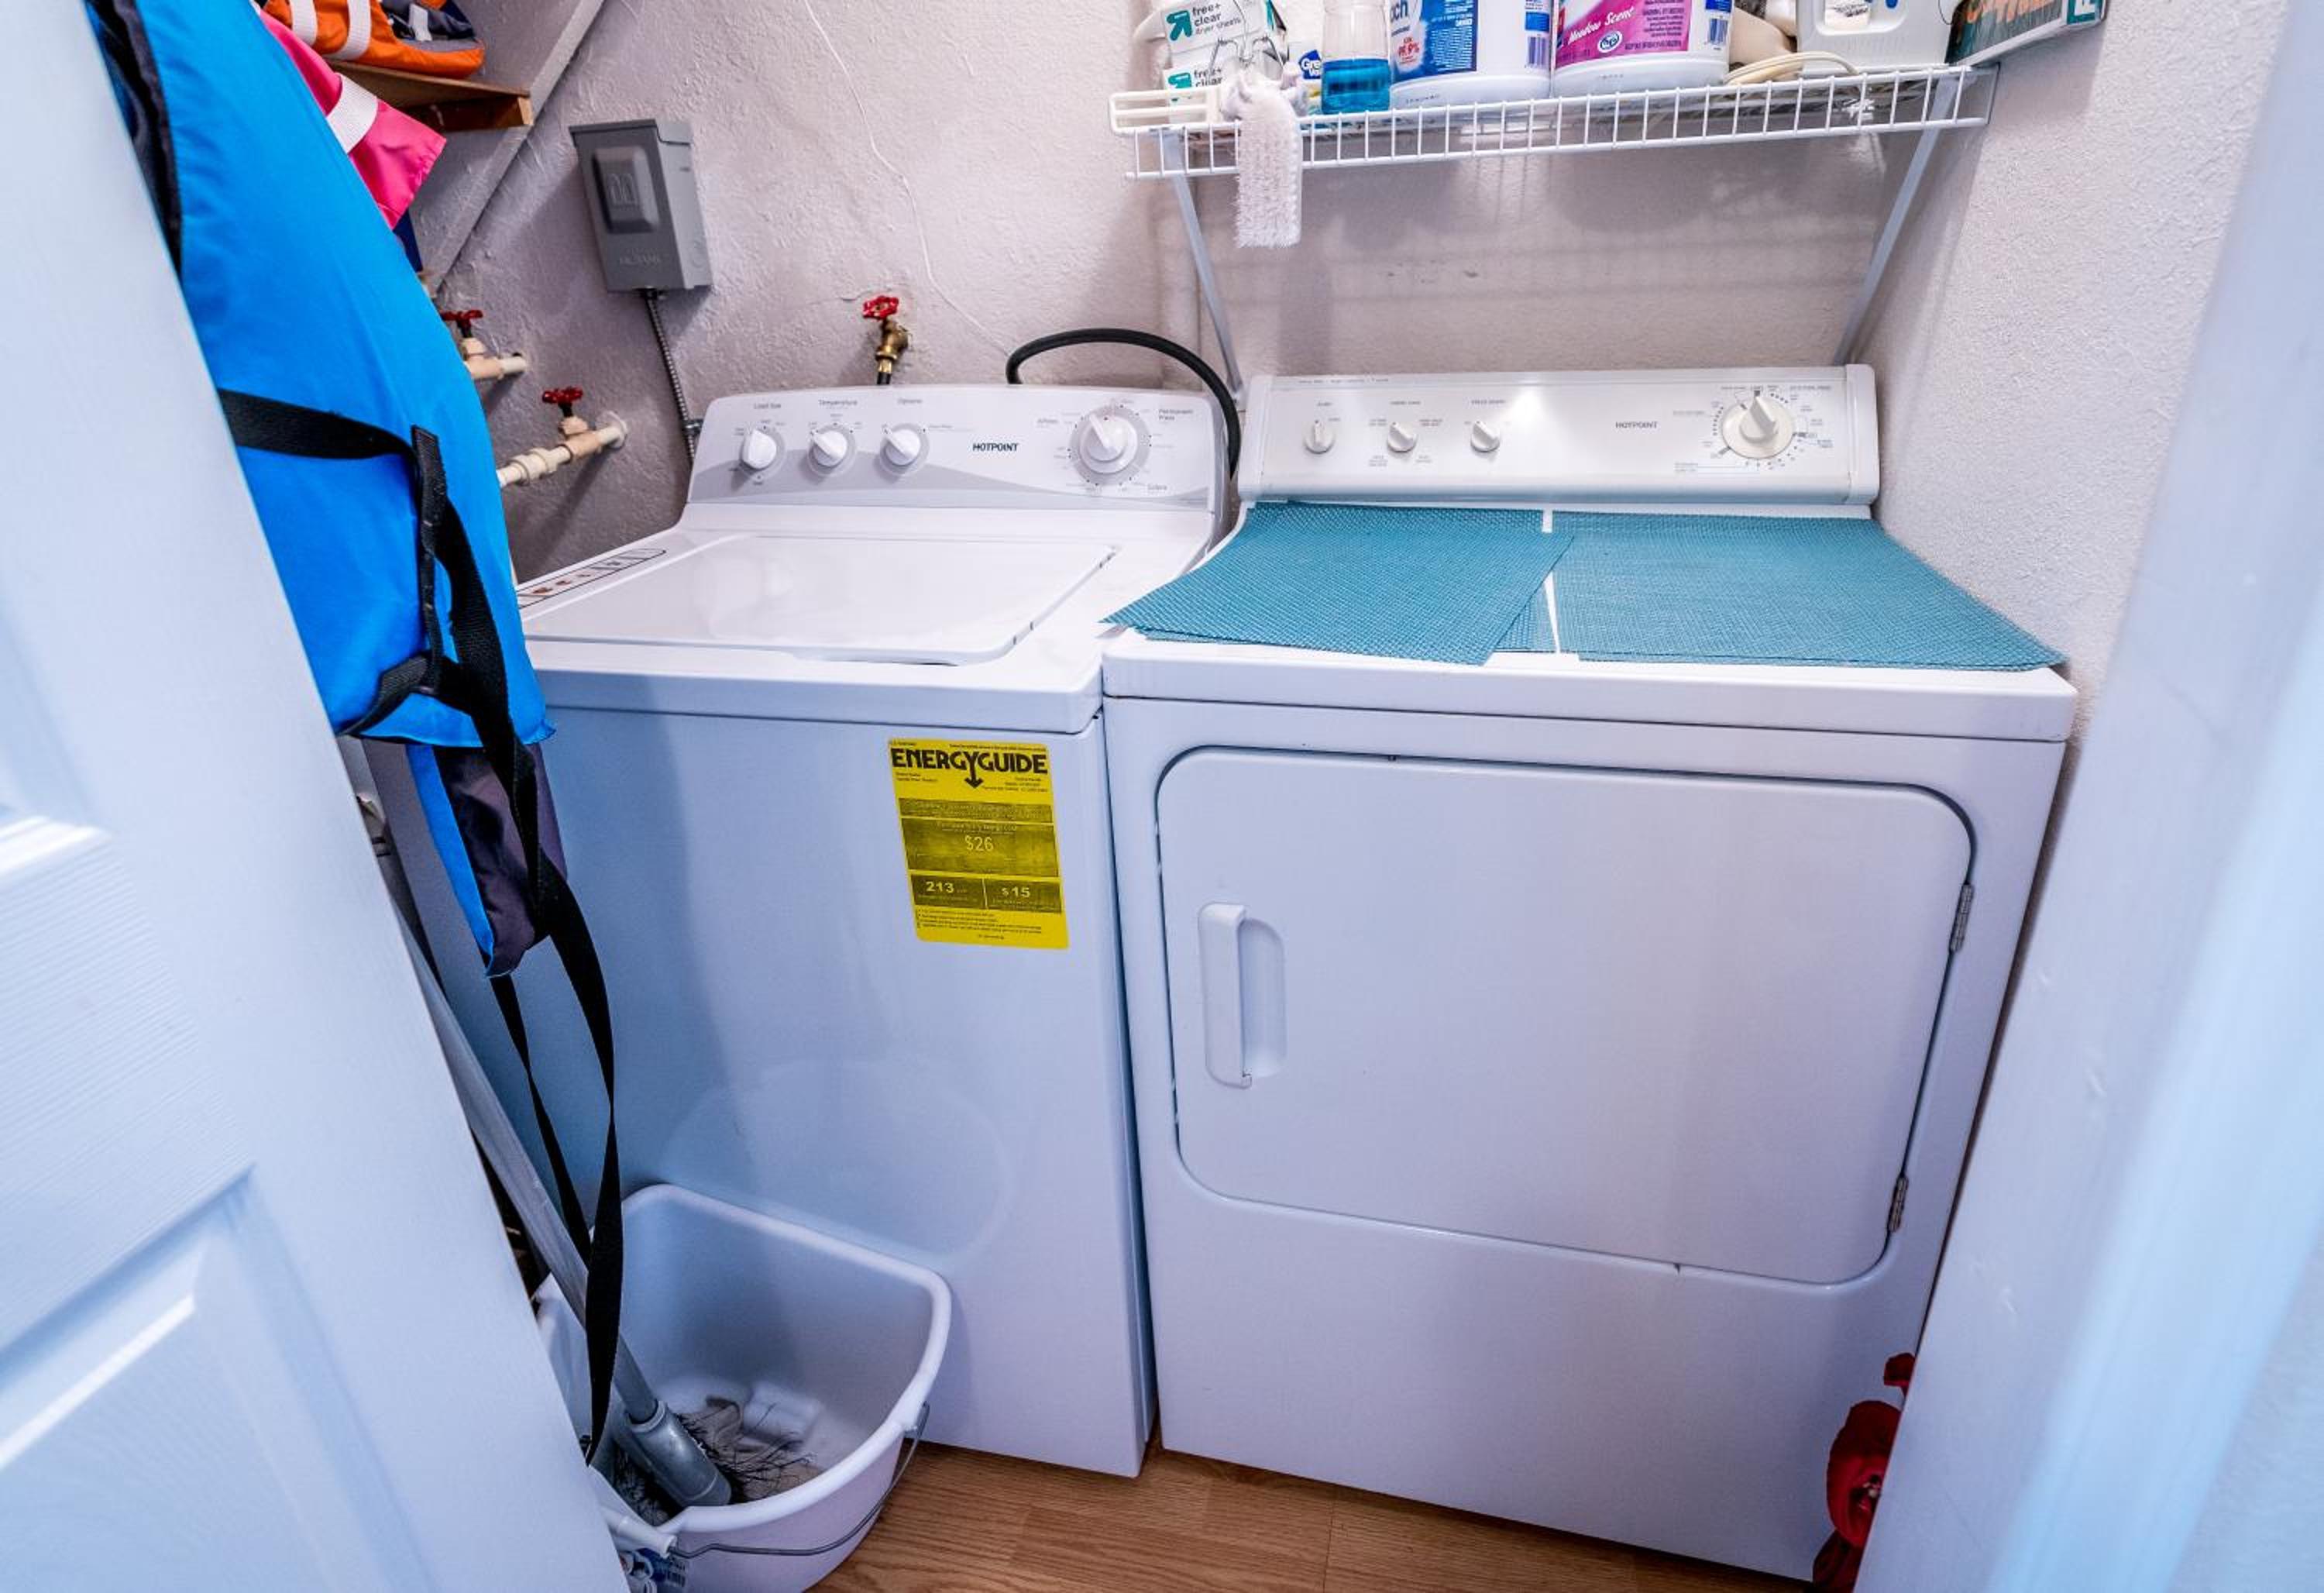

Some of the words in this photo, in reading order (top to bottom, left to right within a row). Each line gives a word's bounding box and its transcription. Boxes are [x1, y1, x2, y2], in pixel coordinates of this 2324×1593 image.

[1192, 2, 1221, 16] free+
[1195, 14, 1222, 27] clear
[1567, 20, 1601, 45] Meadow
[1604, 5, 1635, 26] Scent
[1615, 421, 1659, 429] HOTPOINT
[972, 442, 1018, 452] HOTPOINT
[890, 748, 1048, 777] ENERGYGUIDE
[964, 833, 995, 852] $26
[925, 881, 955, 893] 213
[1001, 886, 1031, 899] $15
